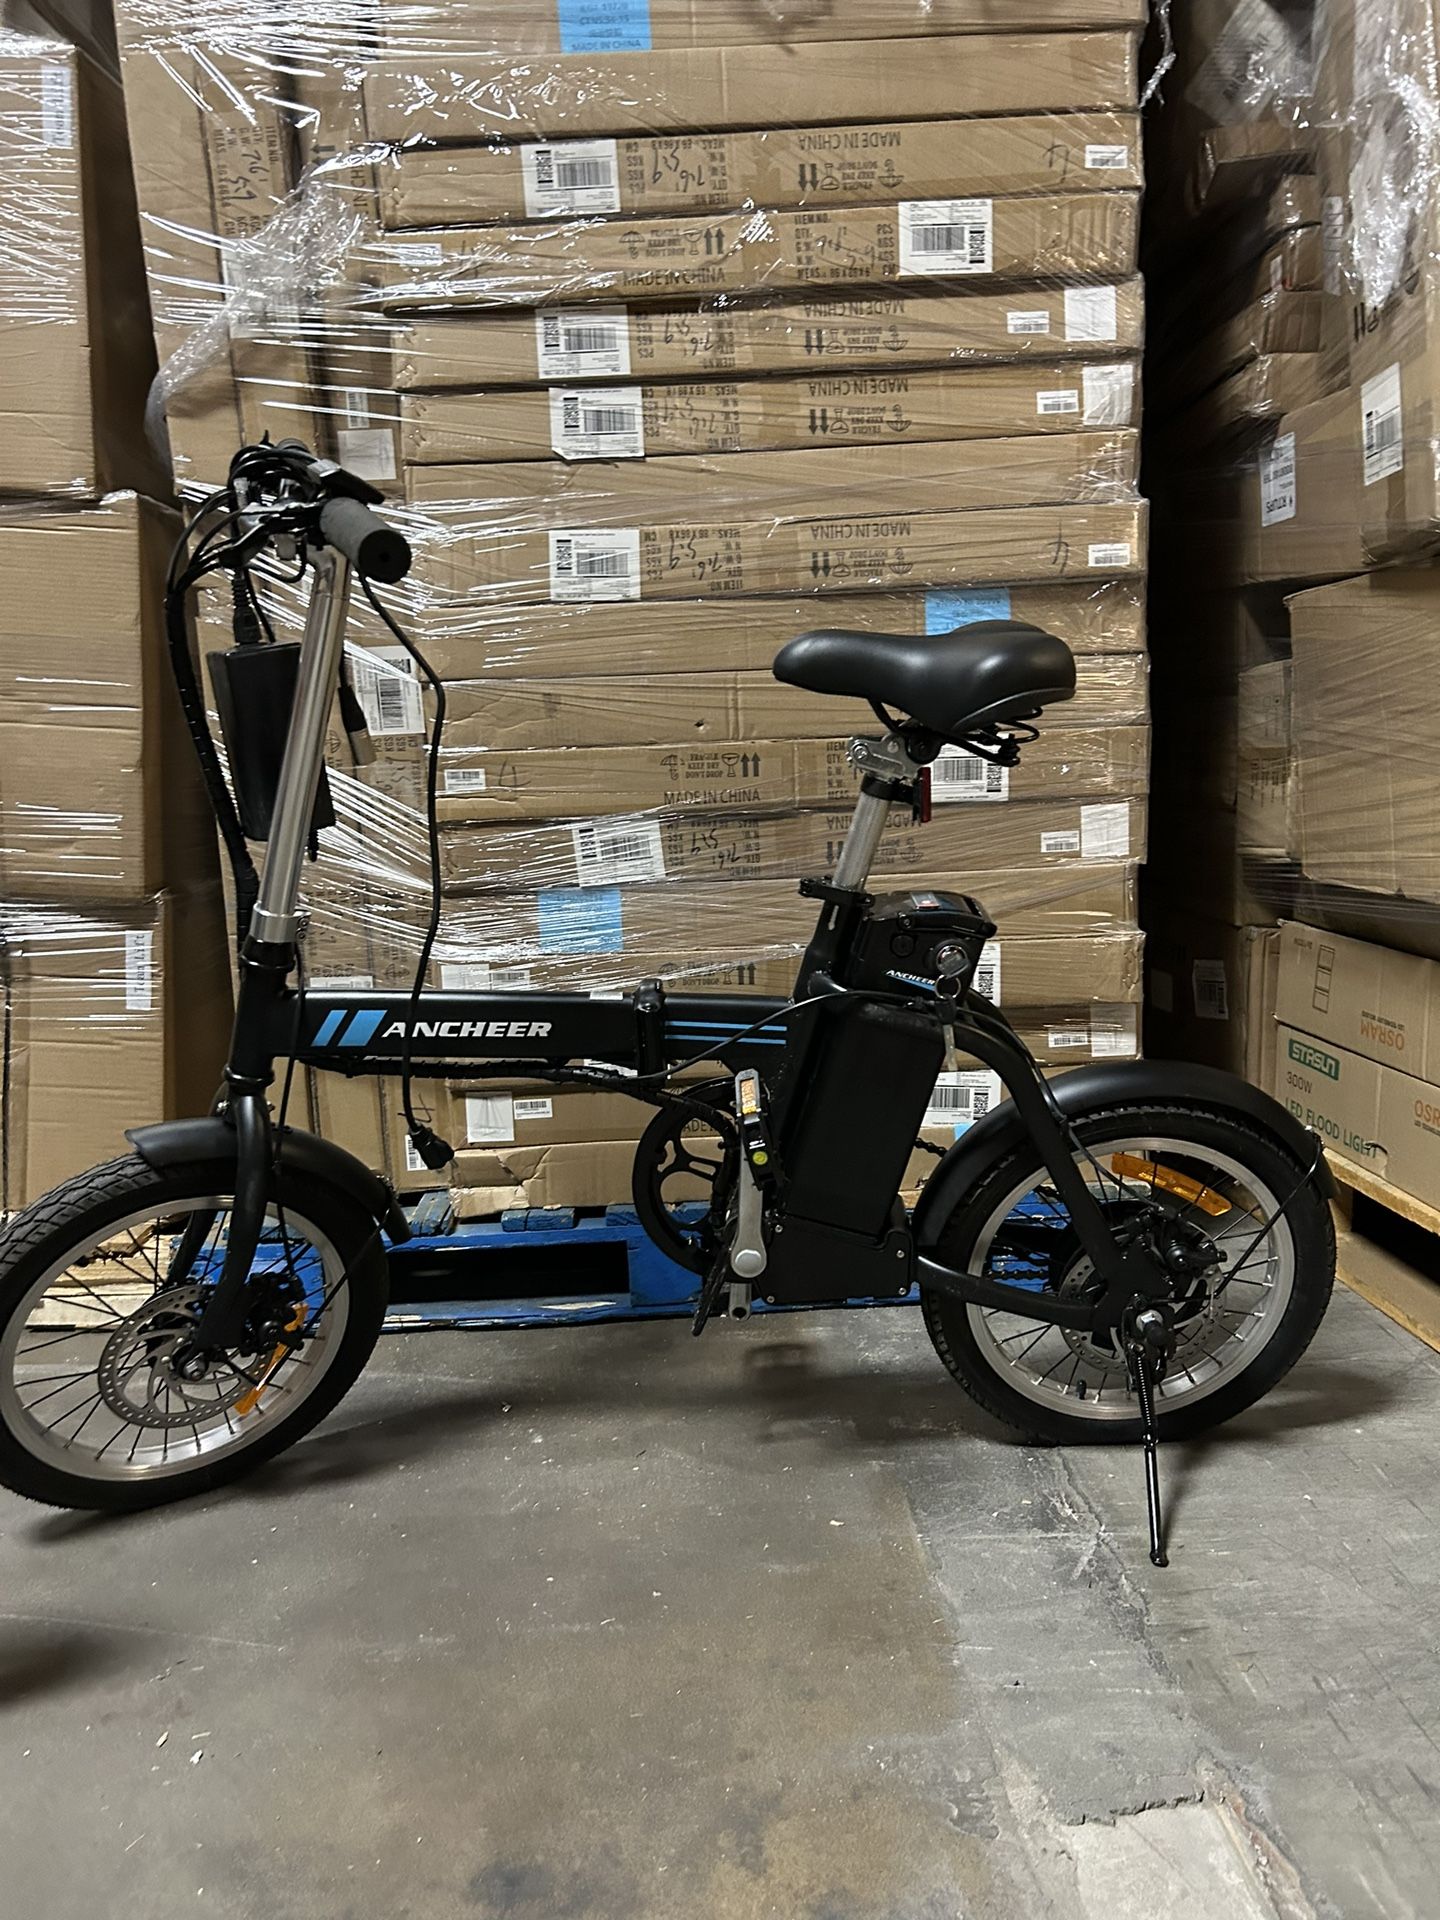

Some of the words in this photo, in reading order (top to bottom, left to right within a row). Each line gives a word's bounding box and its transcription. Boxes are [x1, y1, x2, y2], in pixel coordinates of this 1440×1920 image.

[798, 134, 841, 150] CHINA
[844, 133, 860, 149] IN
[862, 131, 902, 149] MADE
[682, 267, 725, 284] CHINA
[804, 303, 846, 318] CHINA
[865, 300, 905, 315] MADE
[809, 381, 851, 397] CHINA
[854, 380, 869, 394] IN
[870, 378, 909, 393] MADE
[811, 525, 853, 540] CHINA
[856, 524, 871, 538] IN
[873, 521, 911, 538] MADE
[663, 791, 701, 805] MADE
[703, 790, 717, 804] IN
[719, 789, 761, 804] CHINA
[886, 969, 937, 985] ANCHEER
[381, 1021, 552, 1038] ANCHEER
[1361, 1020, 1405, 1051] OSRAM
[1286, 1070, 1313, 1094] 300W
[1306, 1108, 1341, 1139] FLOOD
